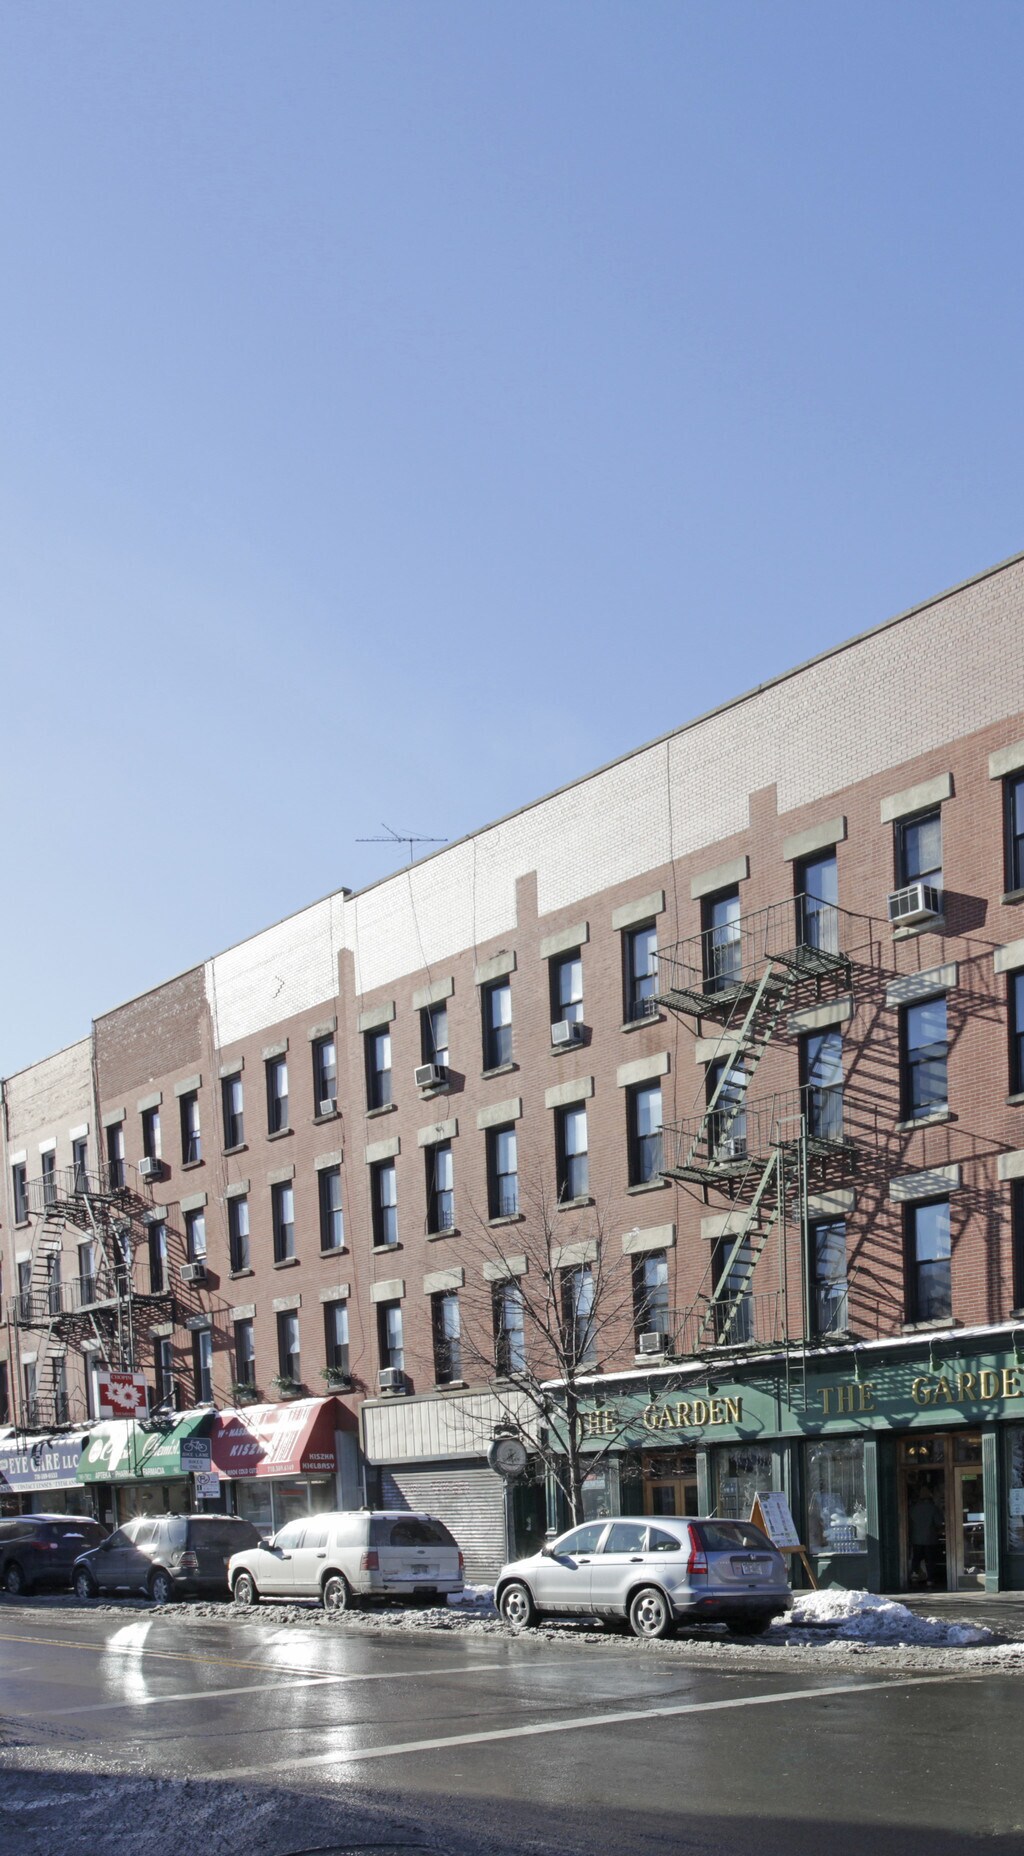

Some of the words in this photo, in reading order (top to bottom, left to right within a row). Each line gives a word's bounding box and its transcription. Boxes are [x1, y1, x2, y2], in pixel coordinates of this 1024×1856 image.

[643, 1396, 743, 1430] GARDEN
[817, 1383, 876, 1415] THE
[9, 1456, 29, 1475] EYE
[31, 1453, 60, 1473] CARE
[63, 1454, 80, 1469] LLC
